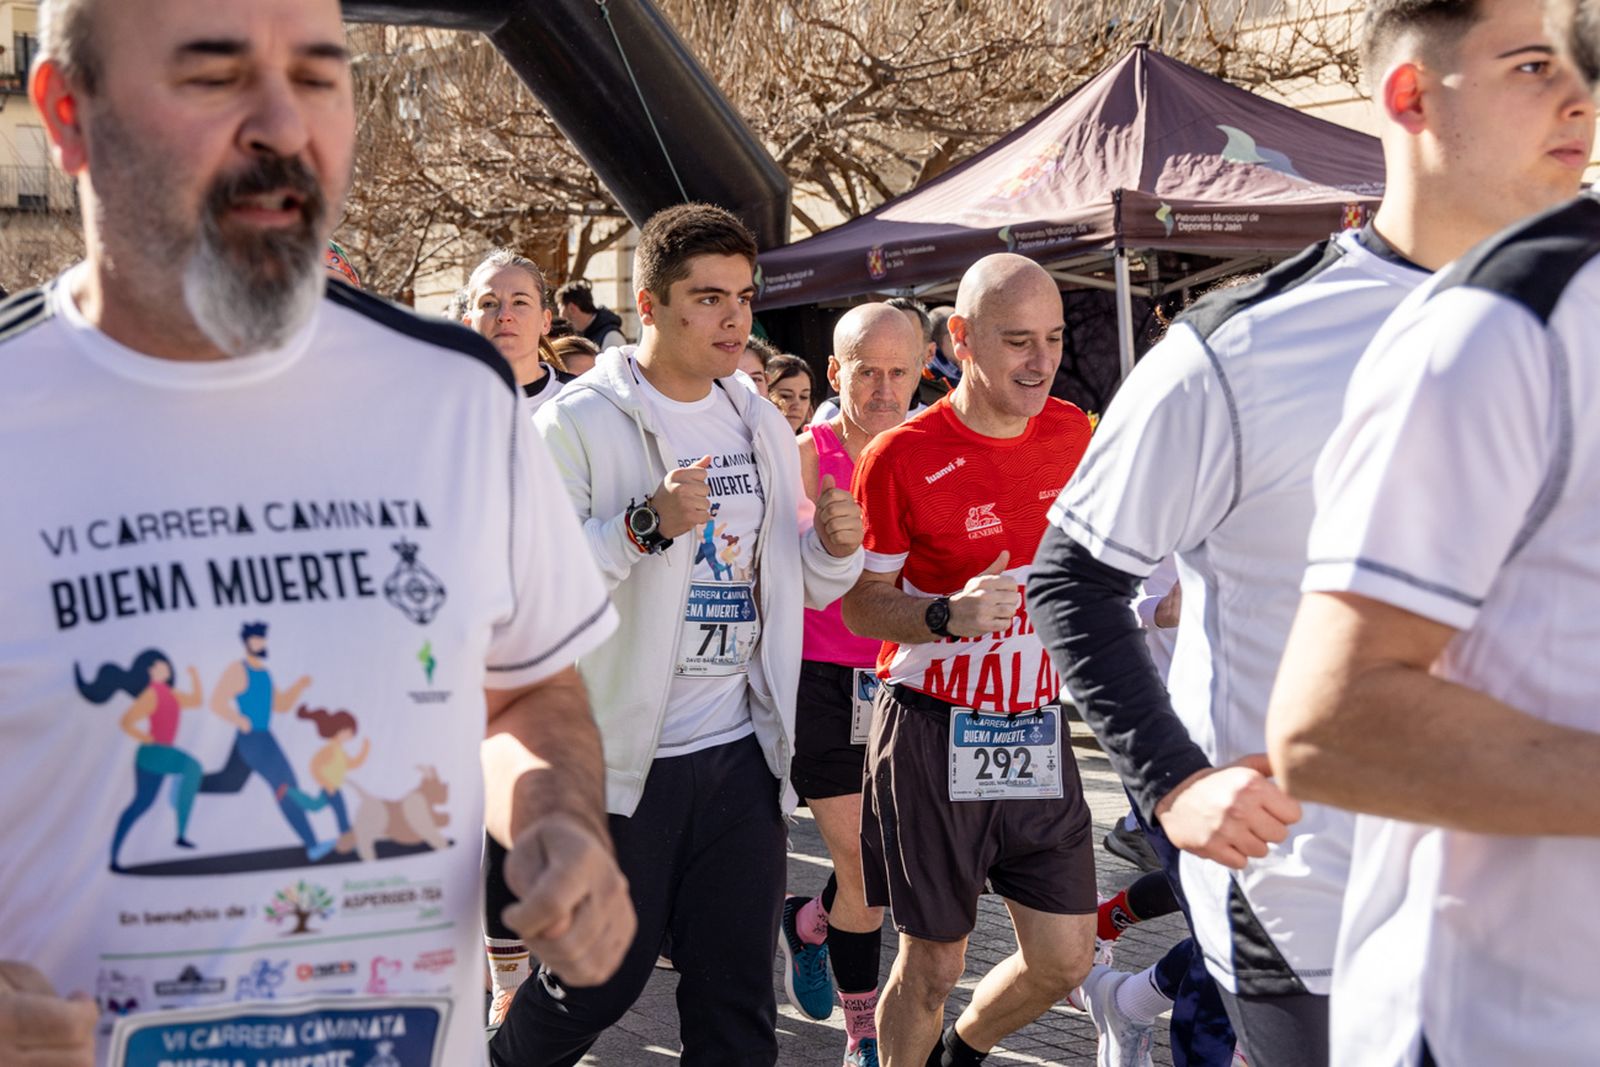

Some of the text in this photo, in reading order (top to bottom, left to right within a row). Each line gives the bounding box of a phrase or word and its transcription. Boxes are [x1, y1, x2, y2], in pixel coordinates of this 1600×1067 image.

[1175, 212, 1260, 223] Patronato Municipal de
[1178, 222, 1242, 232] Deportes de Jaén
[925, 462, 956, 484] luanvi
[40, 496, 432, 557] VI CARRERA CAMINATA
[968, 525, 1003, 540] GENERALI
[50, 549, 378, 631] BUENA MUERTE
[689, 590, 721, 600] ARRERA
[685, 603, 740, 618] ENA MUERTE
[696, 623, 728, 656] 71
[922, 641, 1060, 713] MÁLA
[973, 718, 1010, 729] CARRERA
[963, 729, 1026, 743] BUENA MUERTE
[973, 746, 1034, 780] 292
[118, 905, 246, 927] En beneficio de
[162, 1014, 406, 1051] VI CARRERA CAMINATA
